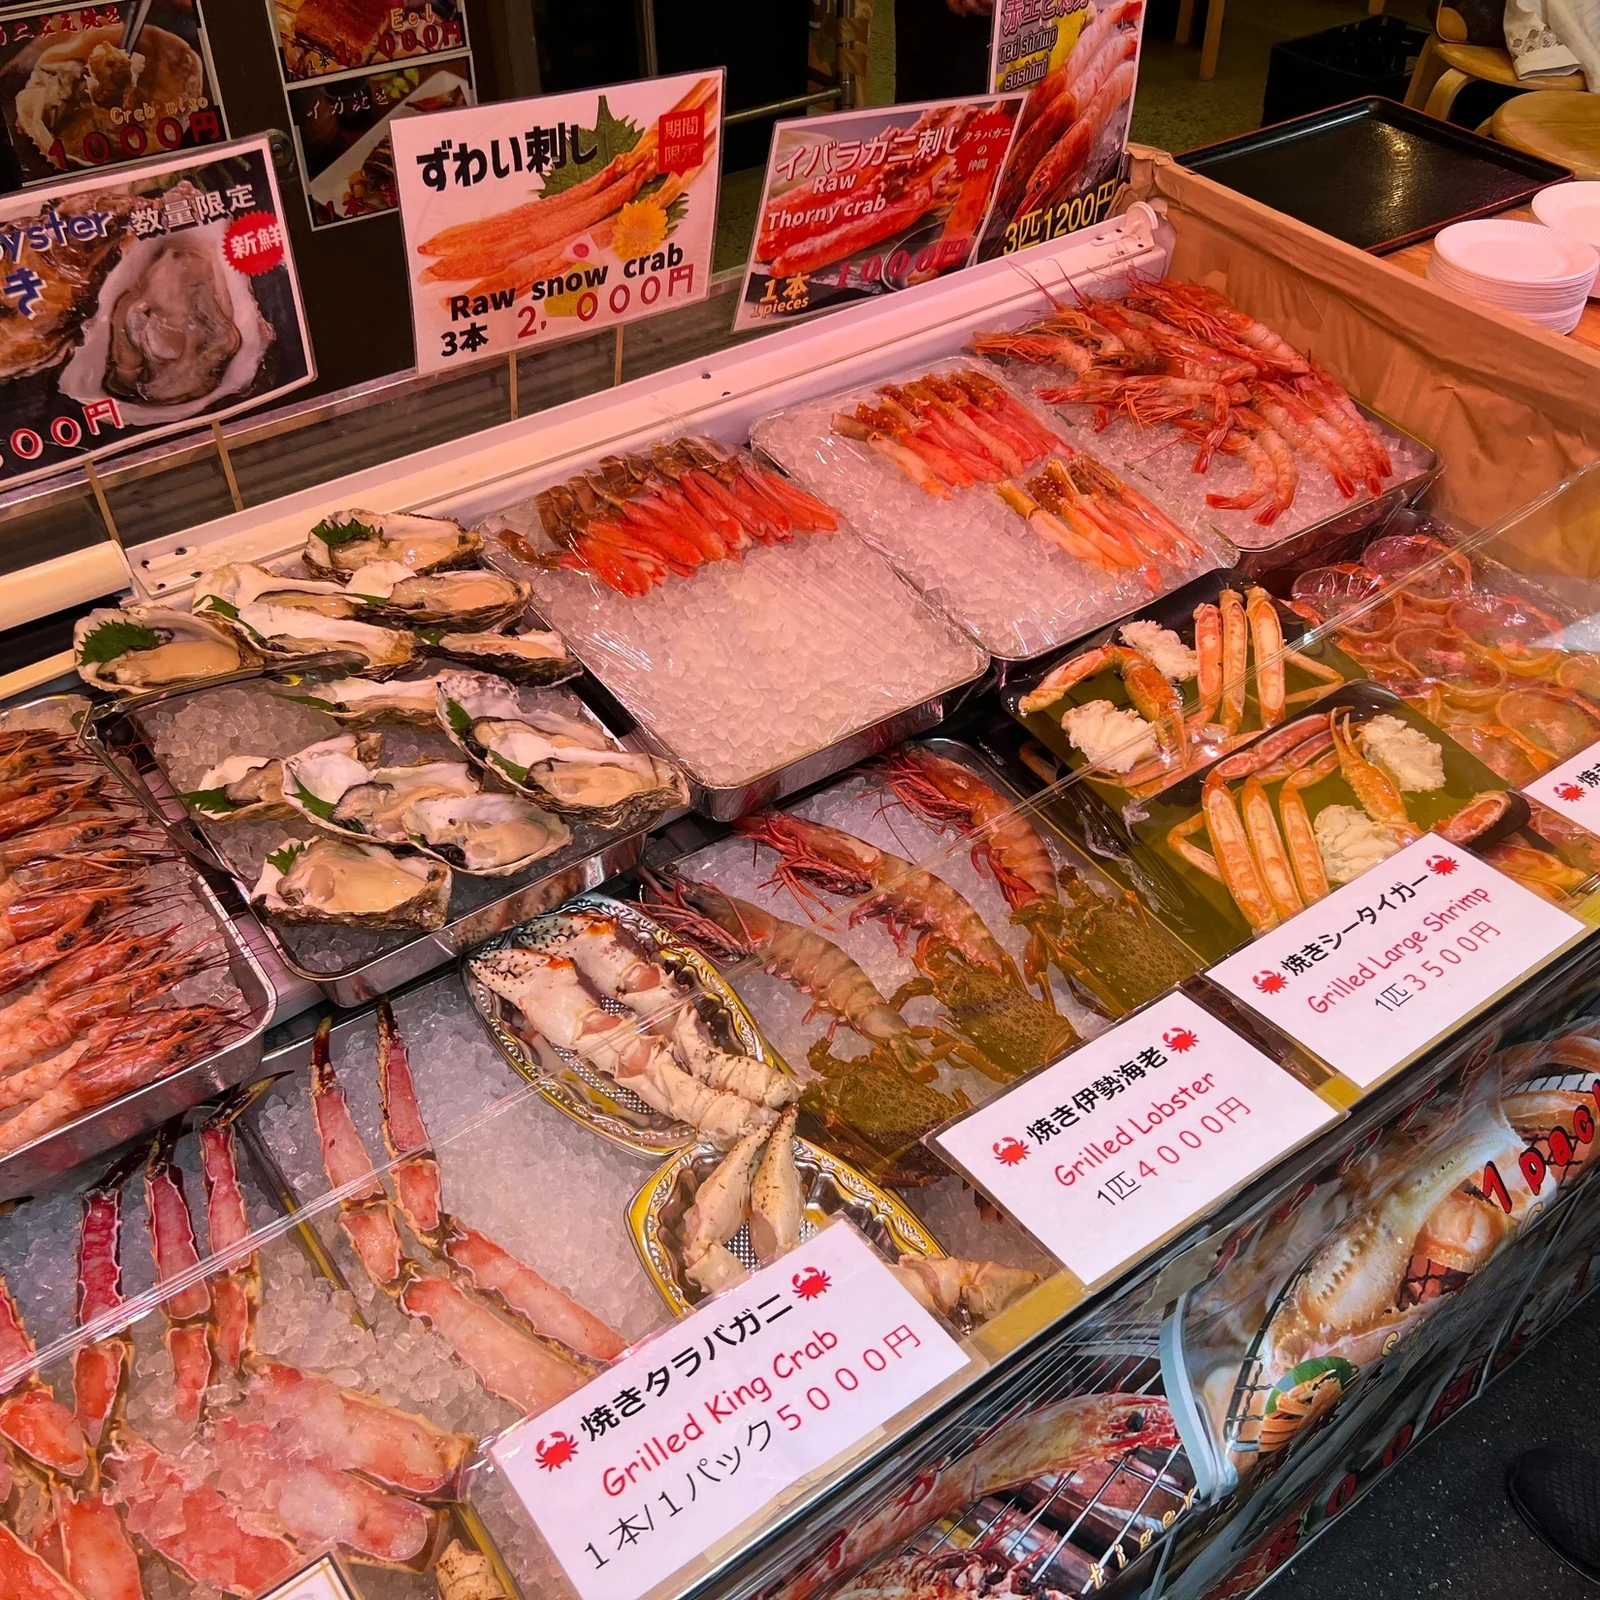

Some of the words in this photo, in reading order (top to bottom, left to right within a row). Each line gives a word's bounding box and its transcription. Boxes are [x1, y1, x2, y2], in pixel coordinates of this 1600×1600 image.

[390, 3, 435, 31] Eel
[999, 35, 1020, 64] red
[1020, 24, 1059, 56] shrimp
[48, 110, 221, 170] 1000円
[109, 102, 157, 125] Crab
[664, 115, 699, 140] 期間
[416, 122, 598, 191] ずわい刺し
[977, 145, 987, 155] の
[813, 173, 857, 194] Raw
[0, 210, 115, 264] yster
[129, 184, 257, 241] 数量限定
[768, 206, 840, 231] Thorny
[843, 194, 887, 217] crab
[1003, 178, 1118, 256] 3匹1200円
[229, 223, 284, 260] 新鮮
[834, 238, 968, 289] 1000円
[4, 267, 48, 320] き
[450, 287, 517, 321] Raw
[531, 265, 609, 301] snow
[623, 243, 684, 279] crab
[750, 305, 761, 318] 1
[763, 297, 810, 317] pieces
[759, 272, 811, 303] 1本
[440, 322, 489, 357] 3本
[0, 398, 125, 468] 00円
[1281, 874, 1429, 977] 焼きシータイガー
[1307, 962, 1376, 1014] Grilled
[1369, 929, 1429, 971] Large
[1422, 886, 1492, 933] Shrimp
[1374, 920, 1501, 1012] 1匹3500円
[1026, 1046, 1169, 1146] 焼き伊勢海老
[1054, 1125, 1135, 1187] Grilled
[1128, 1071, 1217, 1135] Lobster
[1096, 1096, 1252, 1206] 1匹4000円
[1482, 1160, 1513, 1214] 1
[580, 1292, 793, 1442] 焼きタラバガニ
[601, 1414, 705, 1498] Grilled
[704, 1375, 773, 1426] King
[772, 1328, 839, 1380] Crab
[1088, 1486, 1198, 1590] tiger
